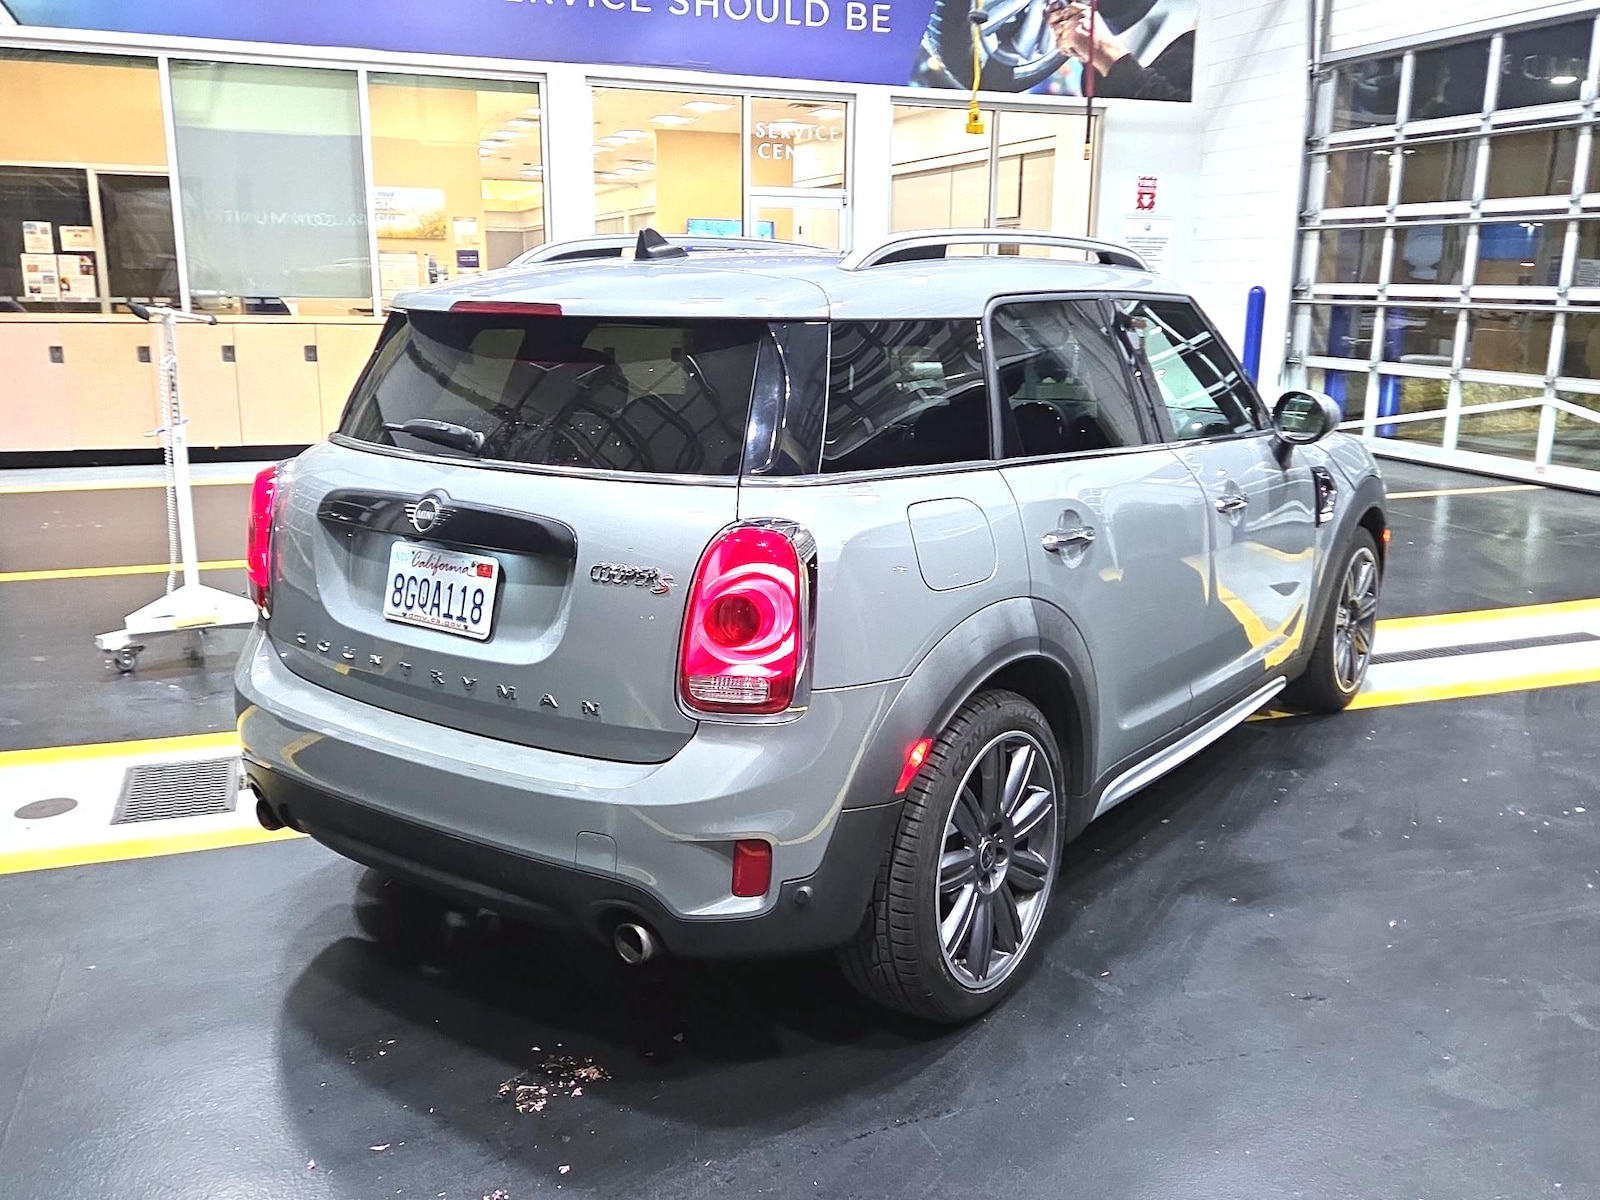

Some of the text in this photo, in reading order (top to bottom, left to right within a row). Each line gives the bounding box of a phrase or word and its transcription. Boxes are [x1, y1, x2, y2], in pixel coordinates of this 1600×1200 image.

[668, 0, 830, 27] SHOULD
[846, 2, 891, 33] BE
[754, 121, 843, 141] SERVICE
[411, 550, 469, 577] California
[391, 573, 485, 625] 8GQA118
[296, 632, 601, 716] COUNTRYMAN
